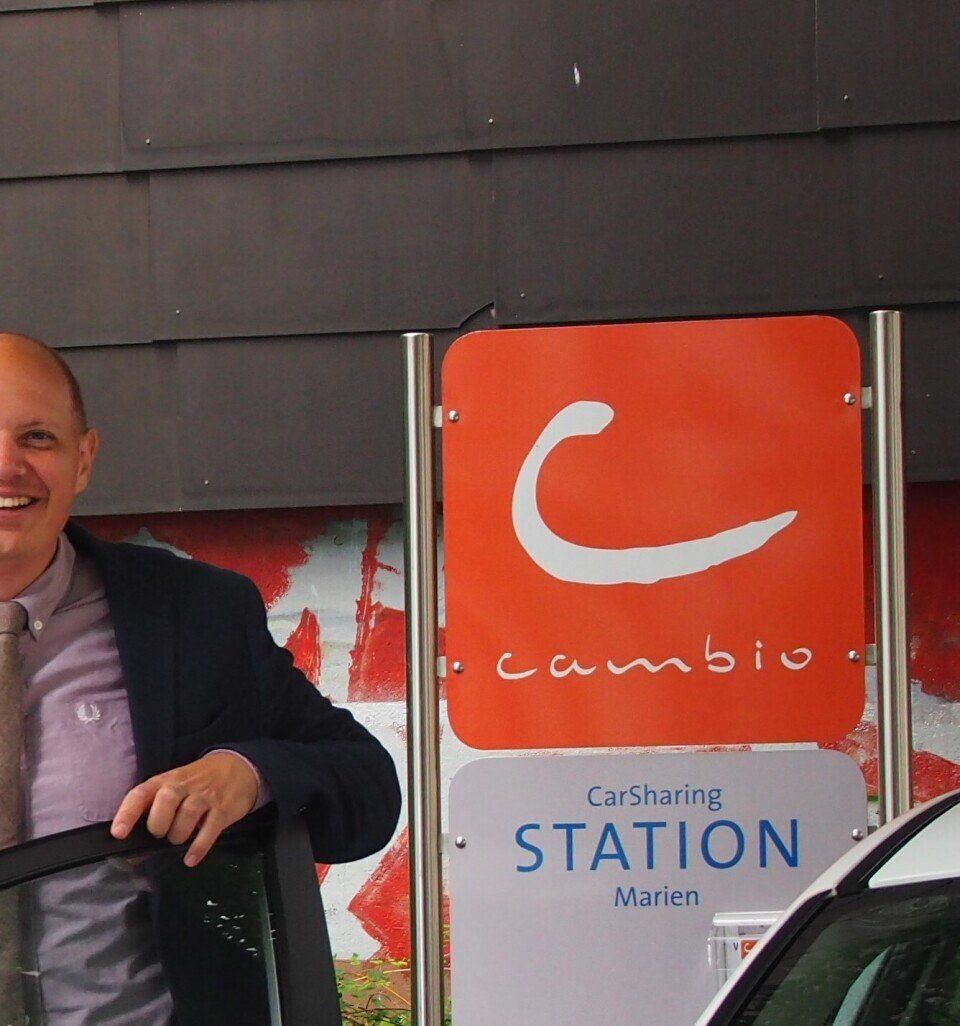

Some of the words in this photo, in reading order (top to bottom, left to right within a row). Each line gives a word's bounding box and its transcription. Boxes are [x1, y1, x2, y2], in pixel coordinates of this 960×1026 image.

[496, 634, 812, 680] cambio
[587, 783, 723, 812] CarSharing
[514, 818, 803, 873] STATION
[614, 885, 700, 908] Marien
